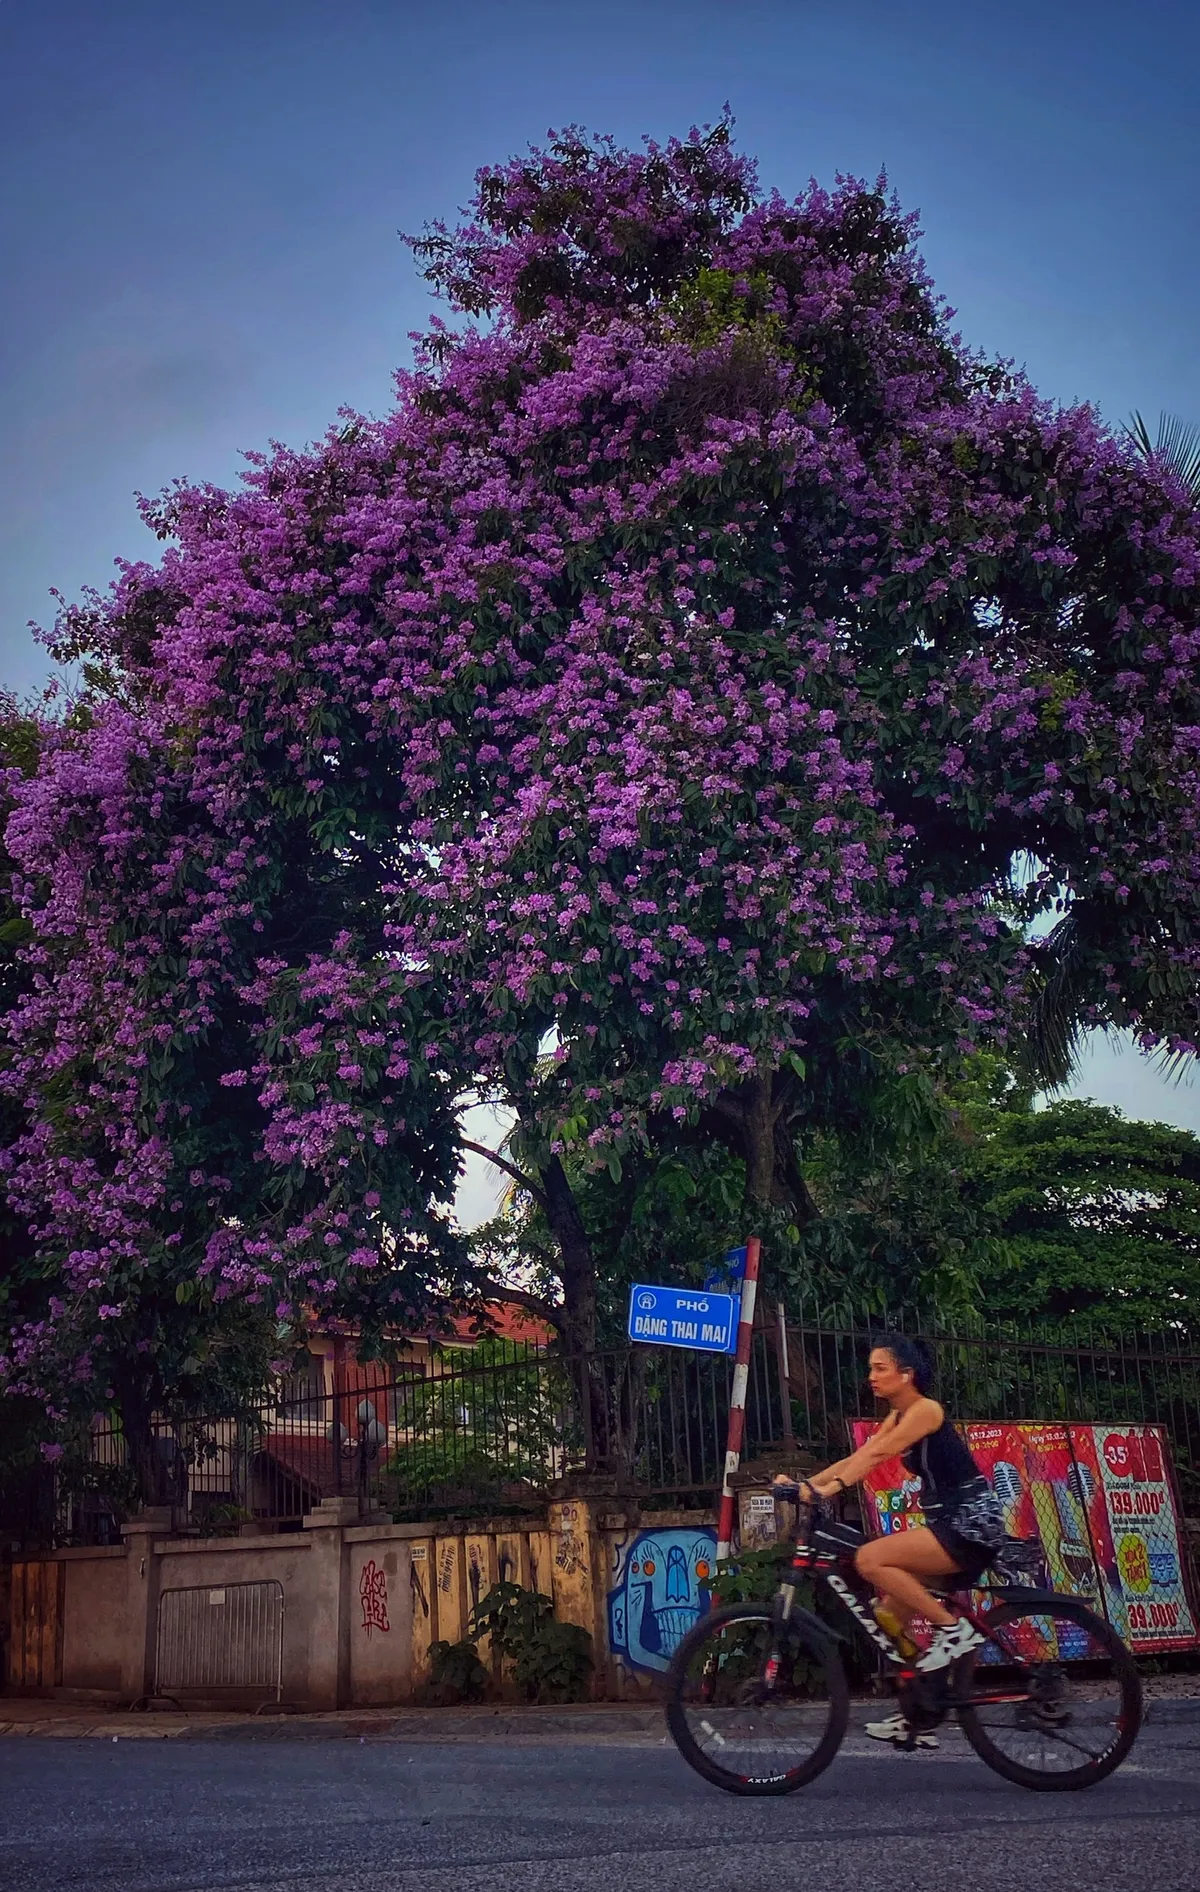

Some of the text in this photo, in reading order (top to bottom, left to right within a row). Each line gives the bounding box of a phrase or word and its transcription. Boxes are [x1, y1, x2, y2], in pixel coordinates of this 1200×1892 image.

[676, 1297, 710, 1313] PHỐ
[634, 1314, 727, 1343] ĐẶNG THAI MAI
[746, 1773, 787, 1784] GALAXY
